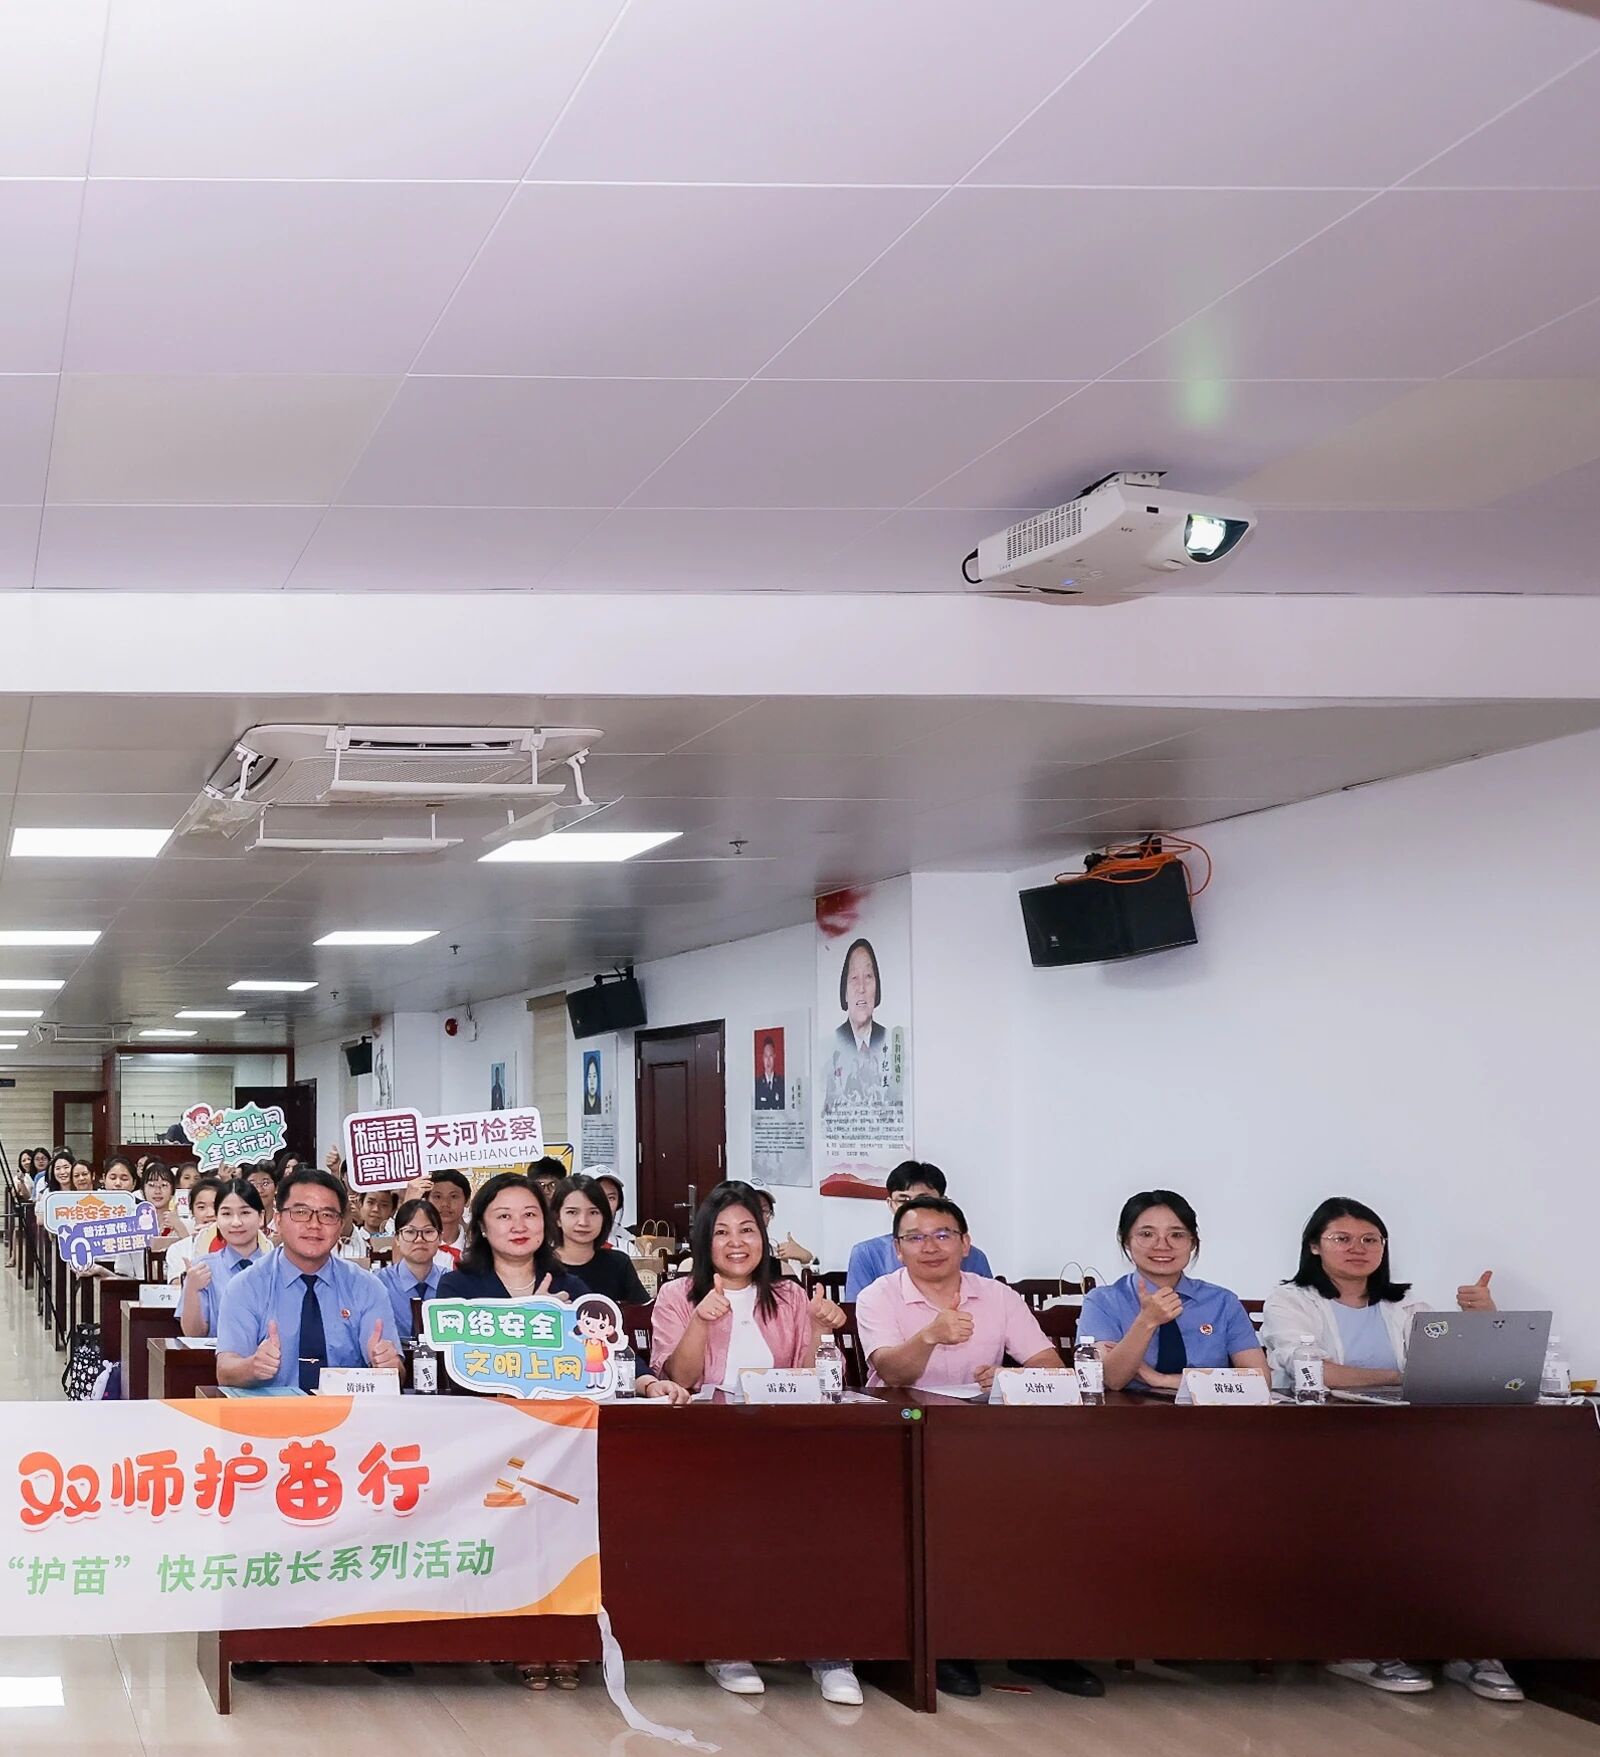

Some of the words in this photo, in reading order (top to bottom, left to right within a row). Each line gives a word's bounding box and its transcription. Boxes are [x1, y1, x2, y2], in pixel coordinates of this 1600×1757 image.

[215, 1110, 281, 1138] 文明上网
[425, 1114, 538, 1149] 天河检察
[207, 1131, 275, 1162] 全民行动
[425, 1144, 539, 1165] TIANHEJIANCHA
[54, 1204, 128, 1220] 网络安全法
[436, 1309, 557, 1341] 网络安全
[463, 1349, 583, 1382] 文明上网
[19, 1436, 430, 1525] 双师护苗行
